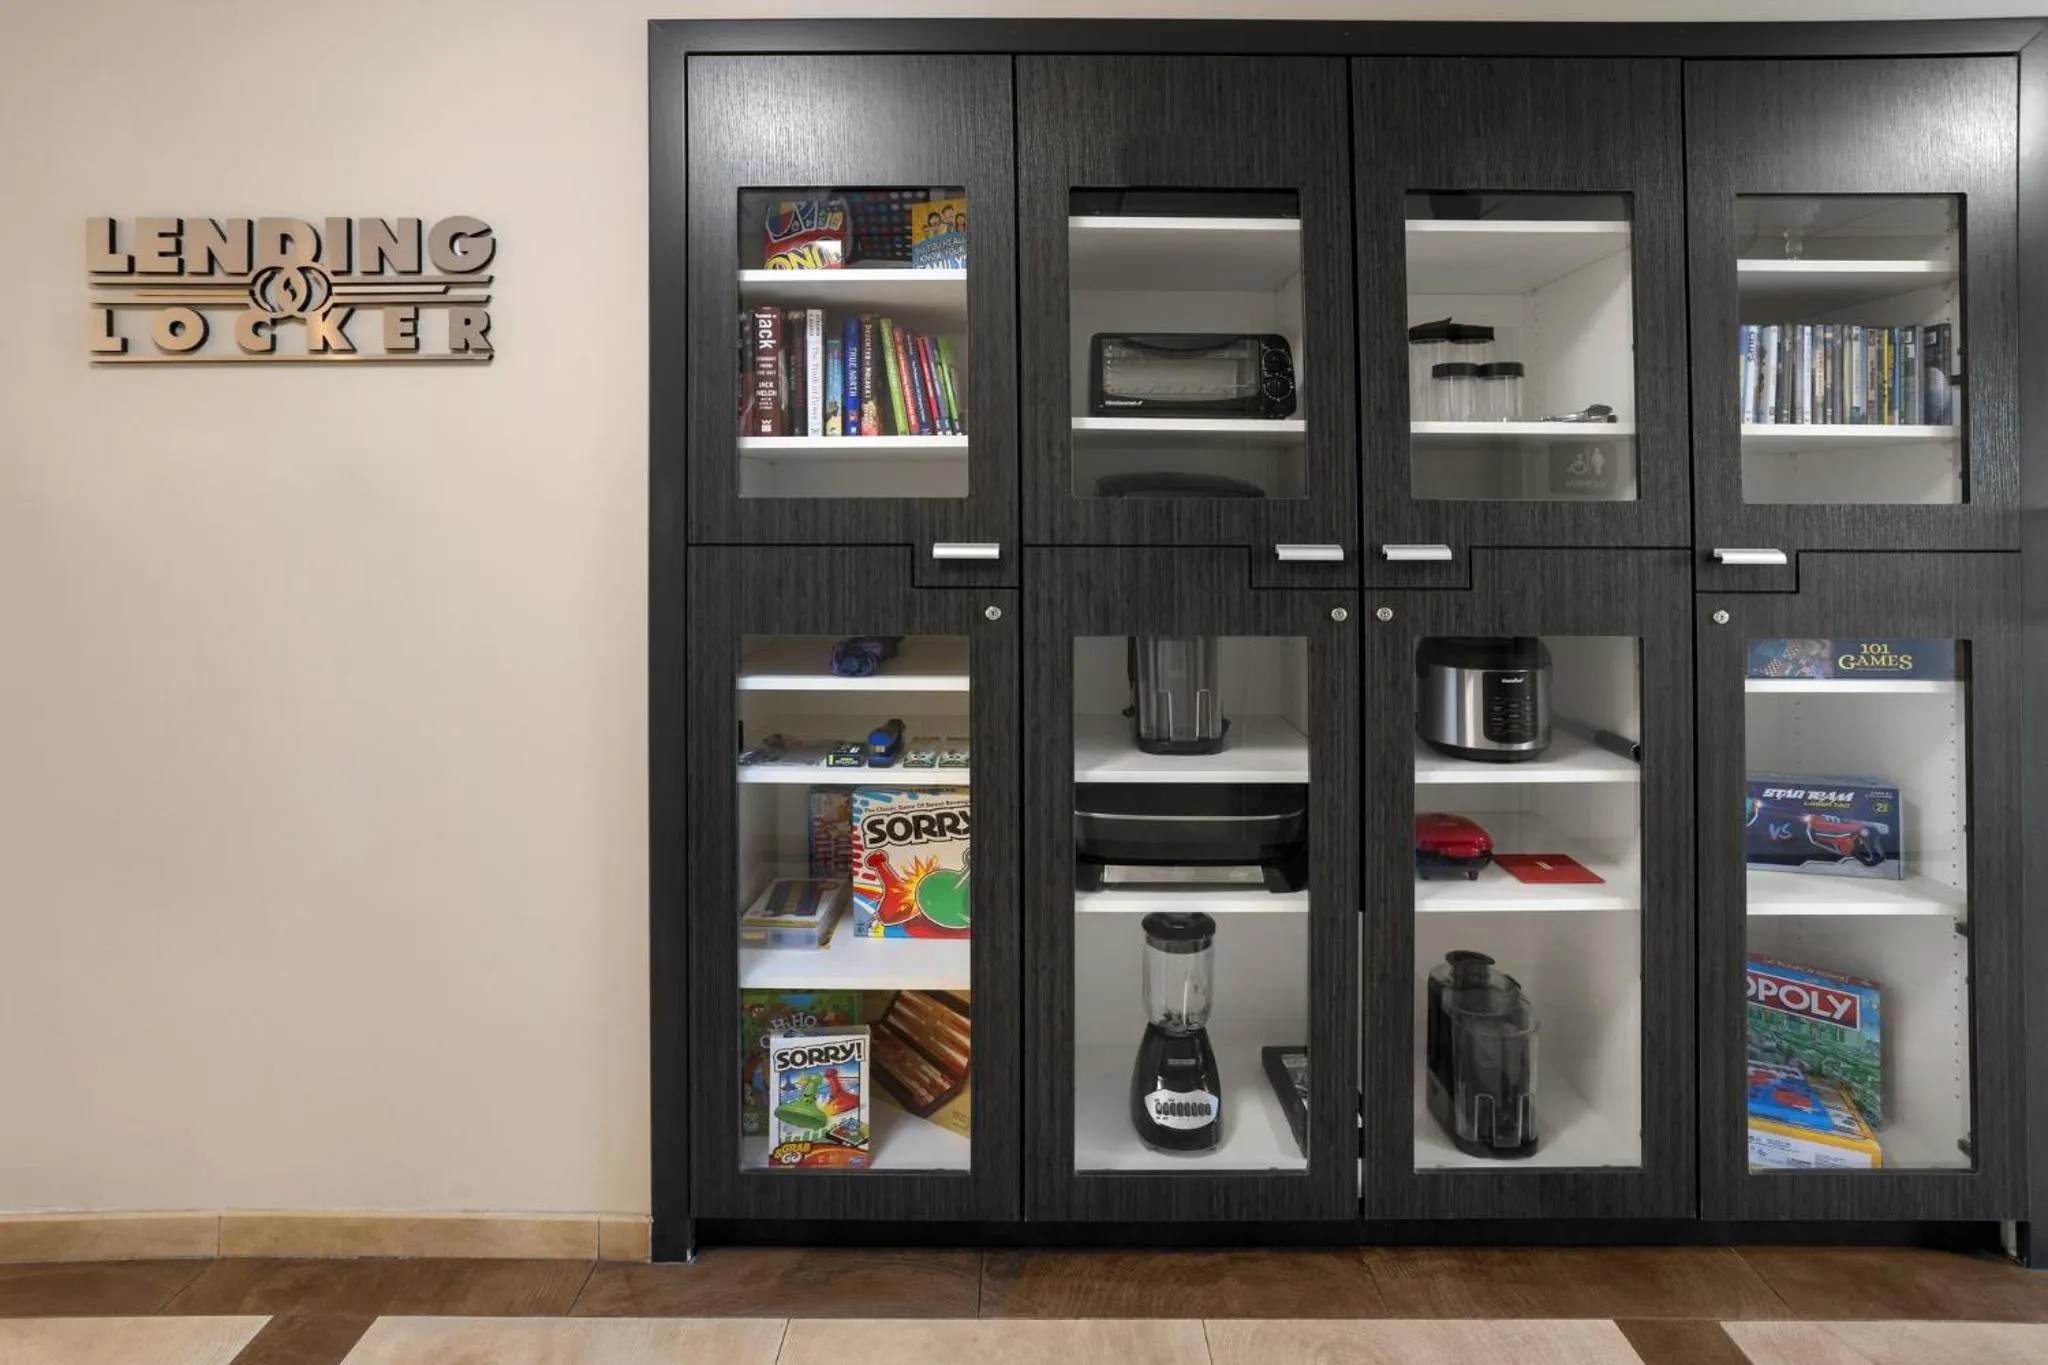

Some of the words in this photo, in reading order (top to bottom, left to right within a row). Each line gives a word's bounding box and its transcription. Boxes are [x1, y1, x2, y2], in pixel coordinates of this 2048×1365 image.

[86, 214, 496, 276] LENDING
[90, 304, 492, 353] LOCKER
[755, 313, 777, 349] jack
[848, 346, 858, 368] TRUE
[848, 369, 858, 397] NORTH
[1860, 643, 1891, 654] 101
[1838, 654, 1913, 671] GAMES
[1807, 790, 1856, 803] TEAM
[1769, 822, 1793, 840] VS
[776, 1041, 864, 1070] SORRY!
[782, 1142, 811, 1153] GRAB
